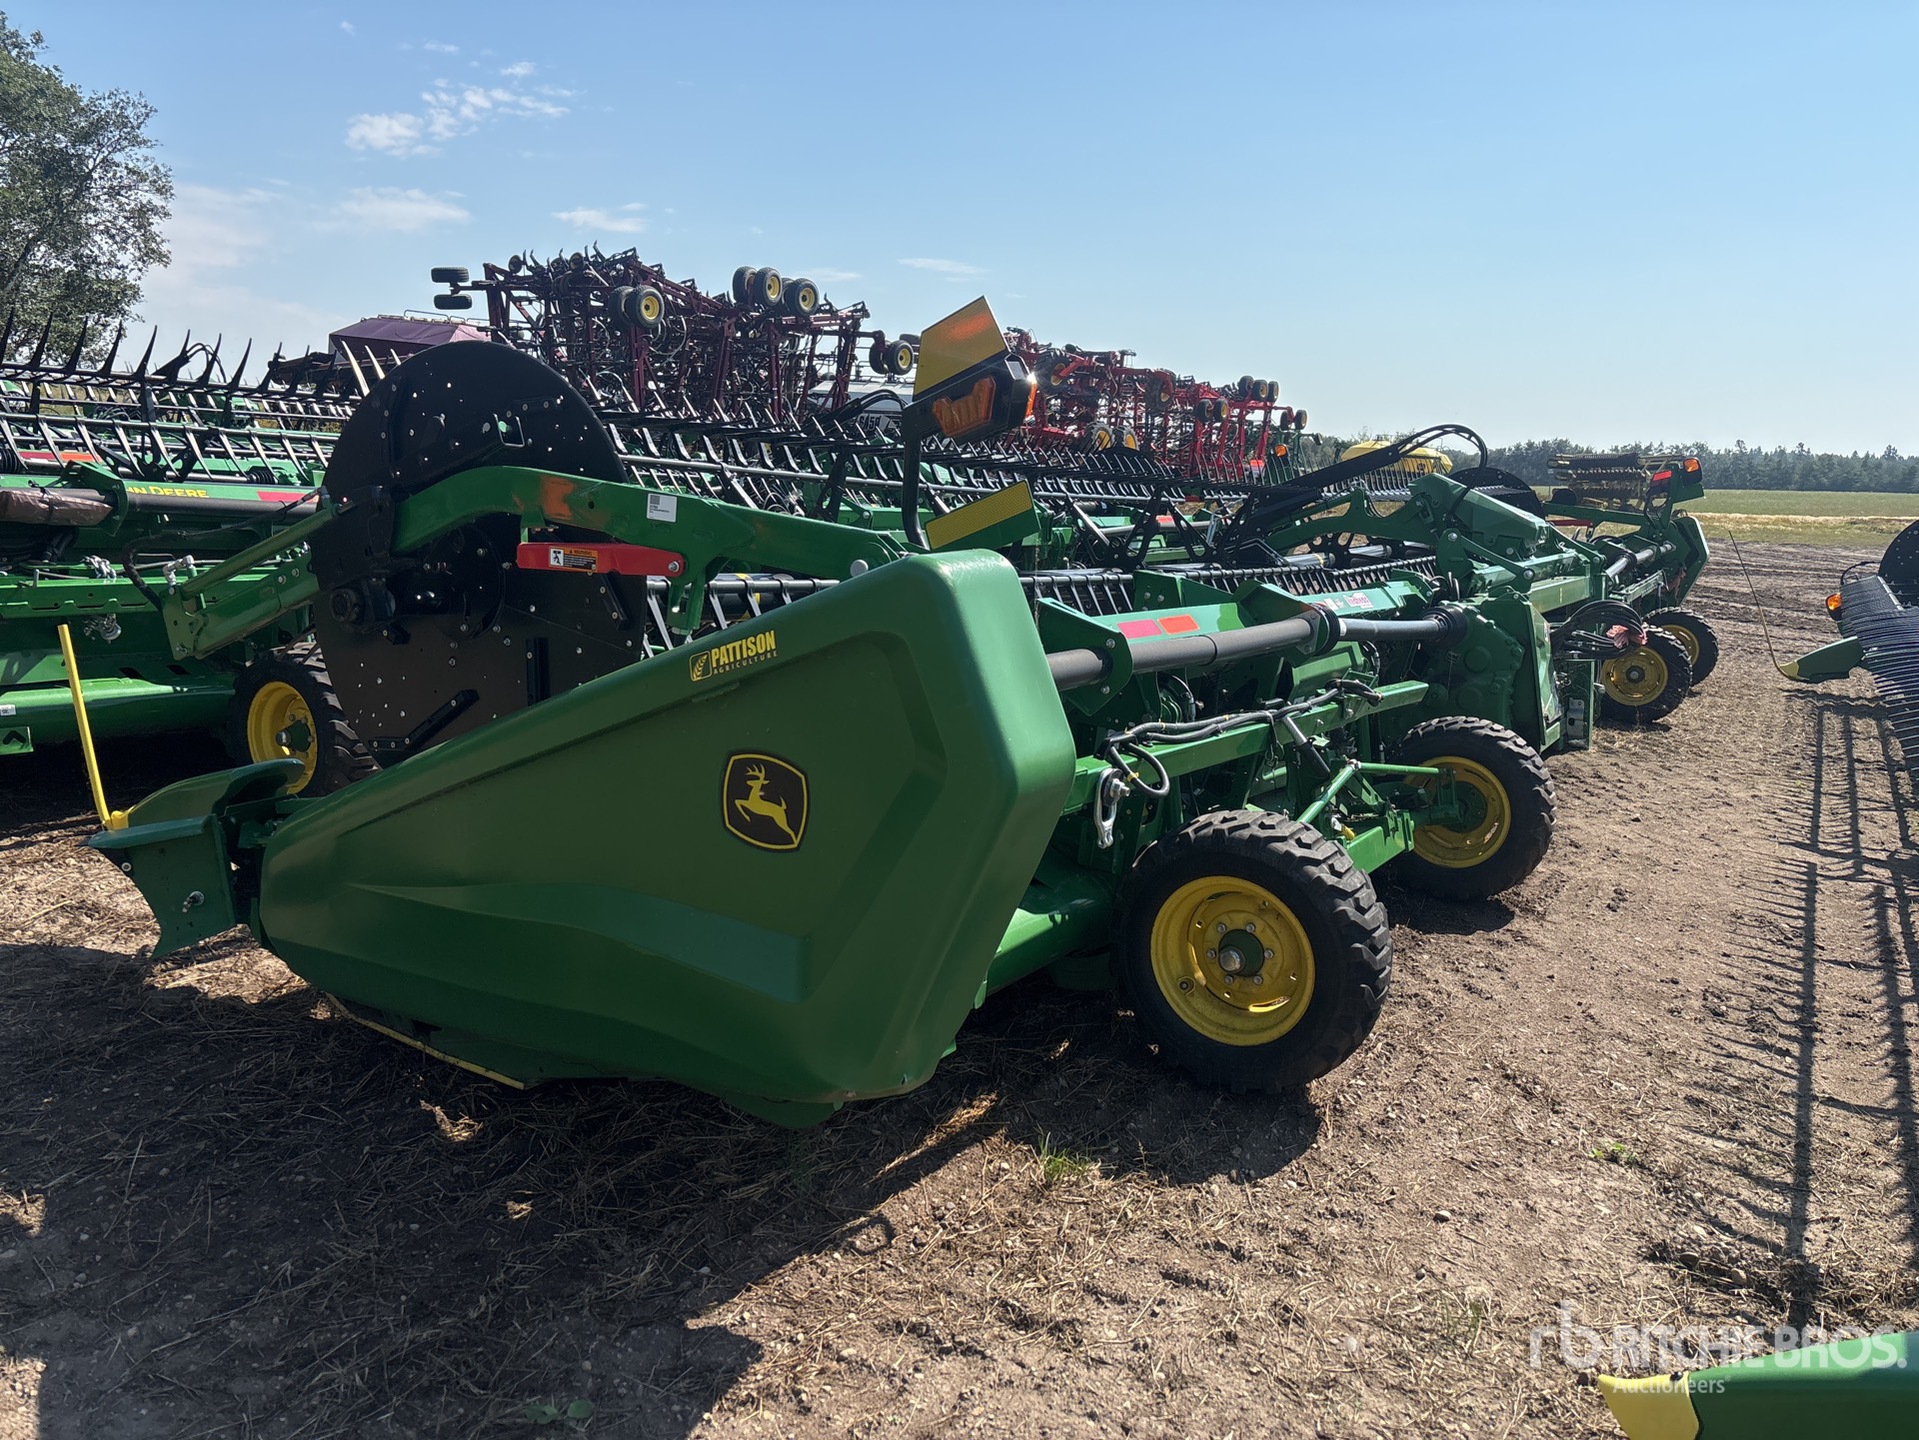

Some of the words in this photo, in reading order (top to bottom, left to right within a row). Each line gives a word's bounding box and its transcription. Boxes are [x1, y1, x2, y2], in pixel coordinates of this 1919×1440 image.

[148, 486, 210, 498] DEERE
[711, 629, 777, 668] PATTISON
[713, 650, 778, 675] AGRICULTURE
